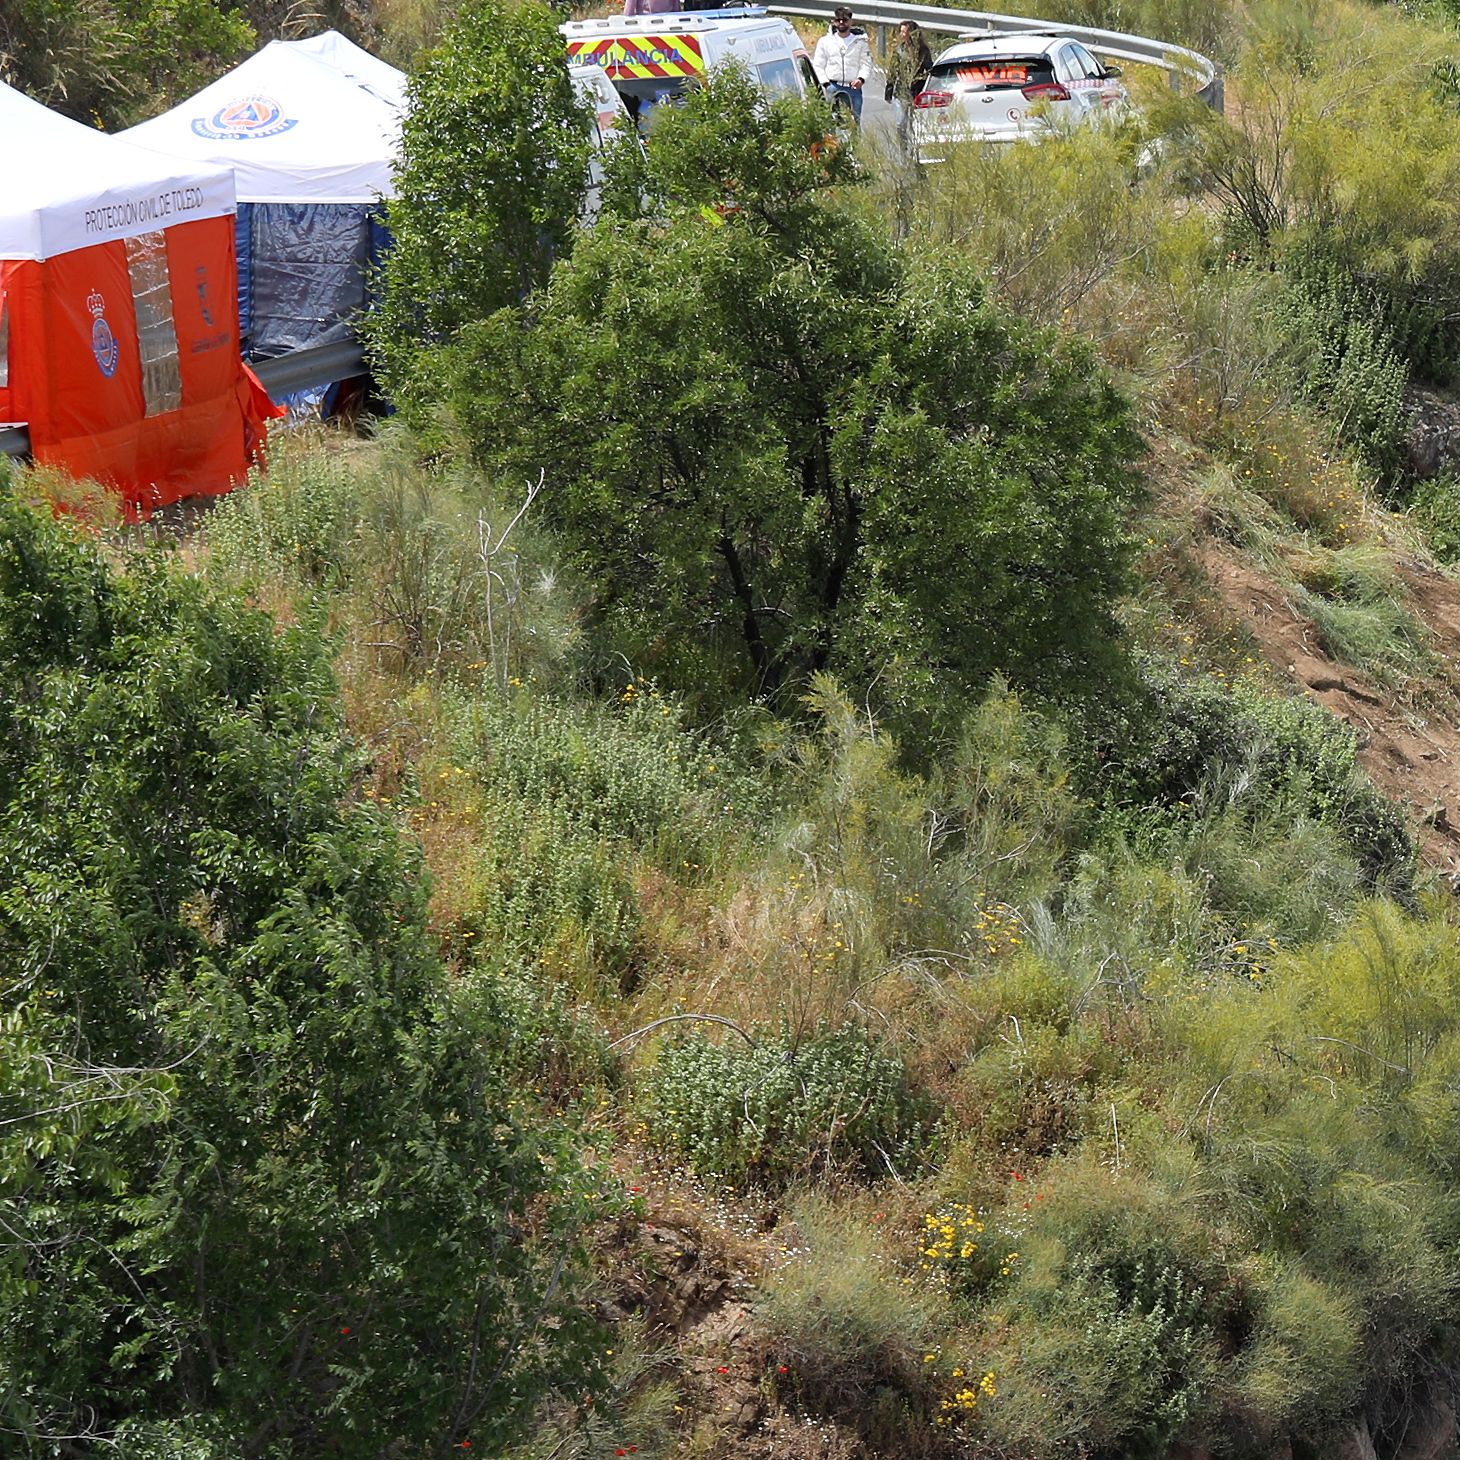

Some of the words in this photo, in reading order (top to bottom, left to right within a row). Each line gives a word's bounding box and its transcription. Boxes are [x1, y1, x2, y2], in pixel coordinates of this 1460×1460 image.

[566, 47, 683, 69] MBULANCIA
[85, 200, 138, 232] PROTECCIÓN
[139, 197, 158, 222] CIVIL
[159, 193, 170, 216] DE
[171, 187, 204, 215] TOLEDO
